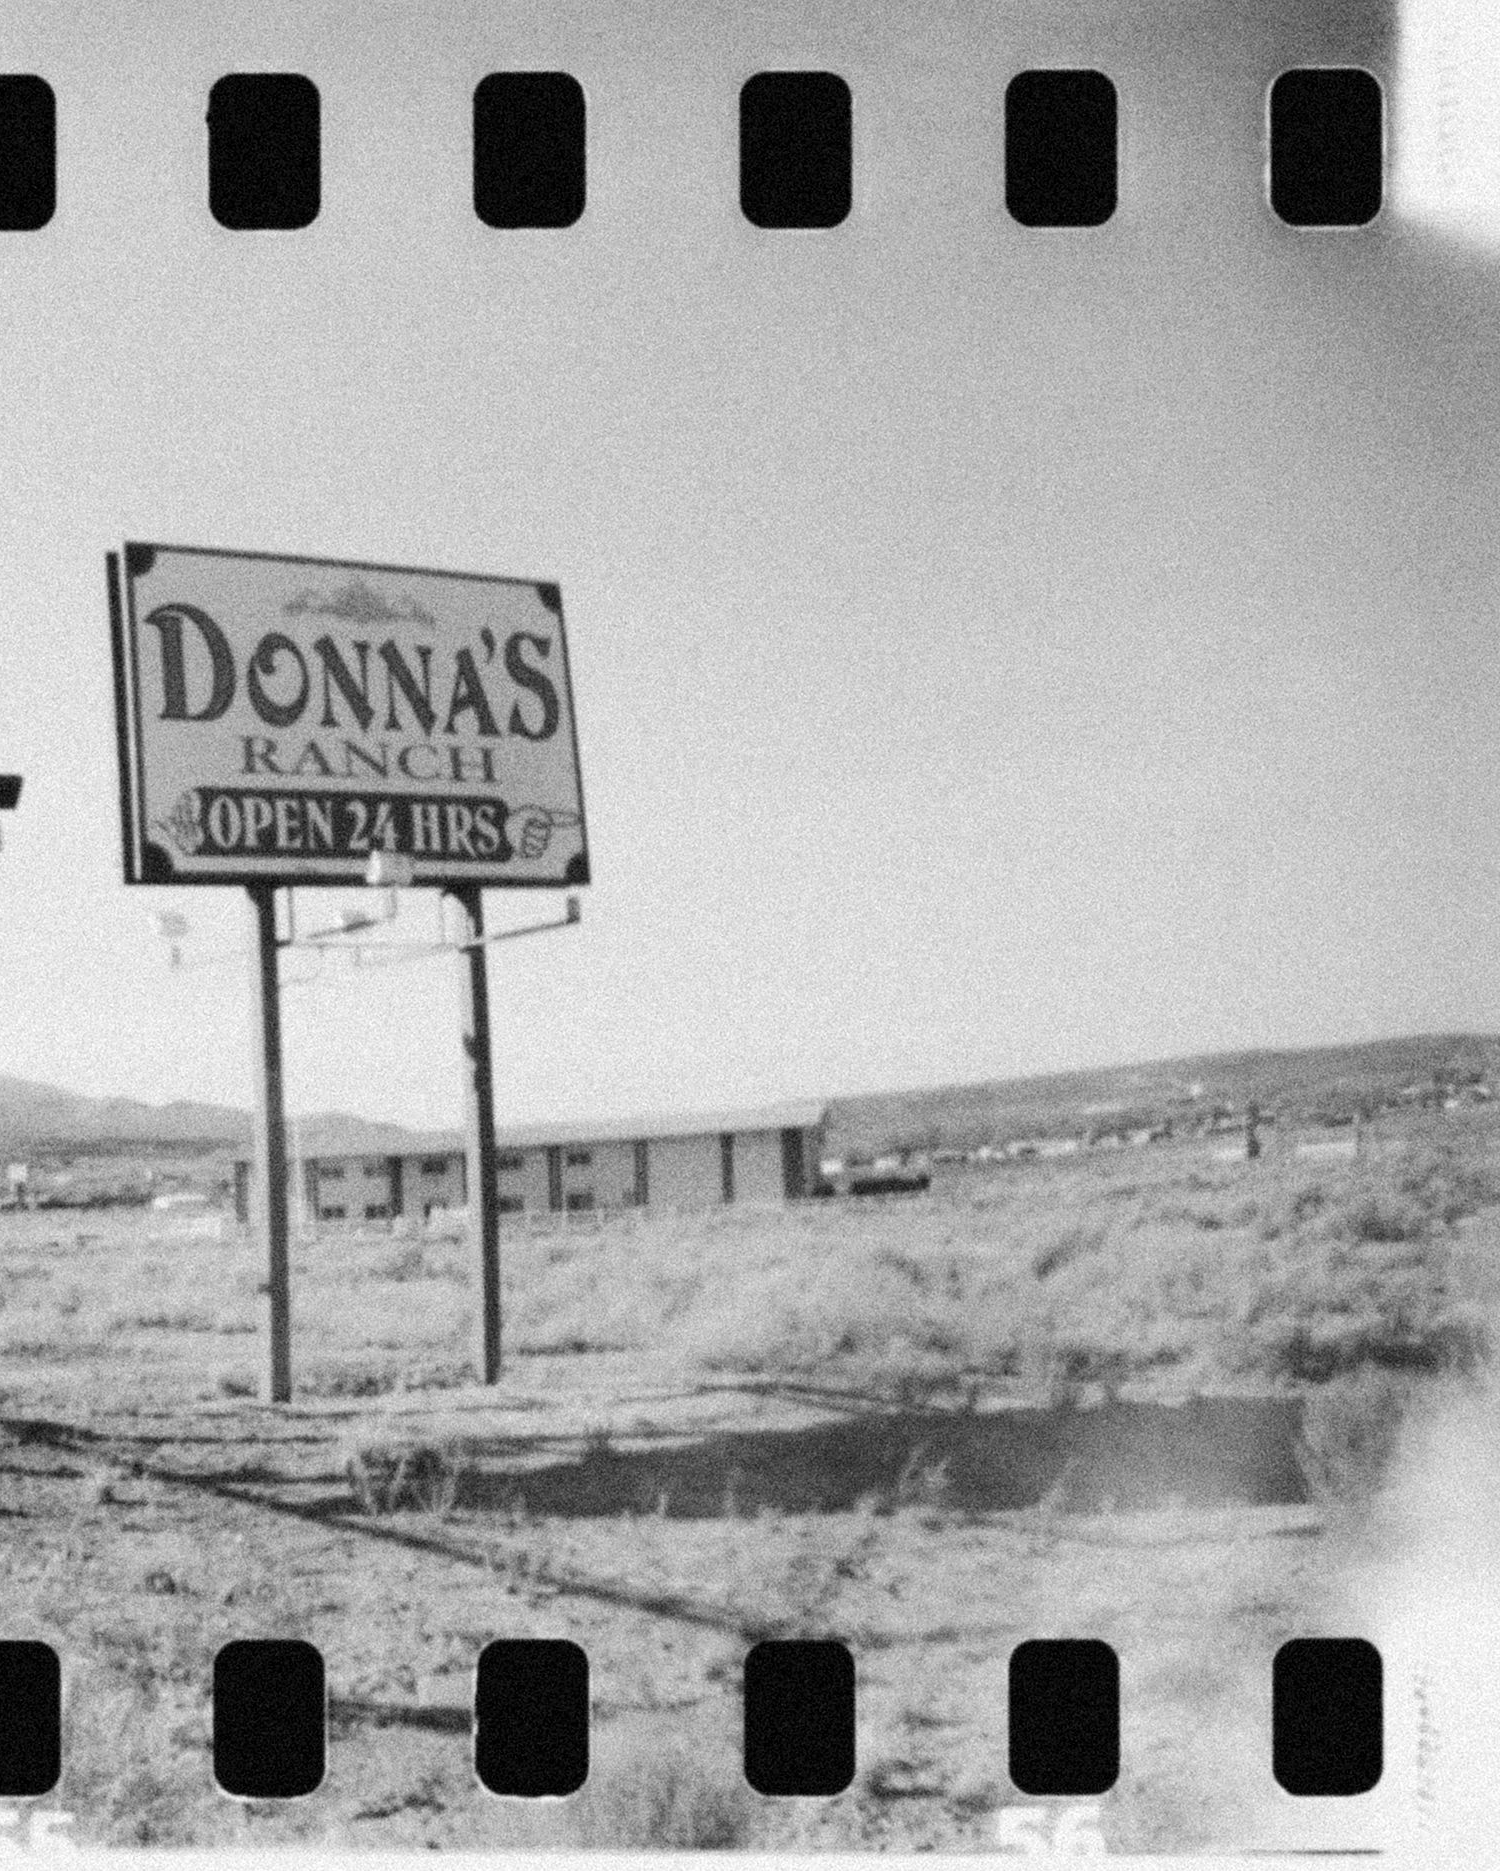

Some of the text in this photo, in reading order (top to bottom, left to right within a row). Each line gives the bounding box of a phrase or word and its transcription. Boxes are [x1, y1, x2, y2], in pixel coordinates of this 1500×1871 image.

[143, 602, 560, 742] DONNA'S
[240, 735, 499, 783] RANCH
[208, 795, 502, 858] OPEN 24 HRS
